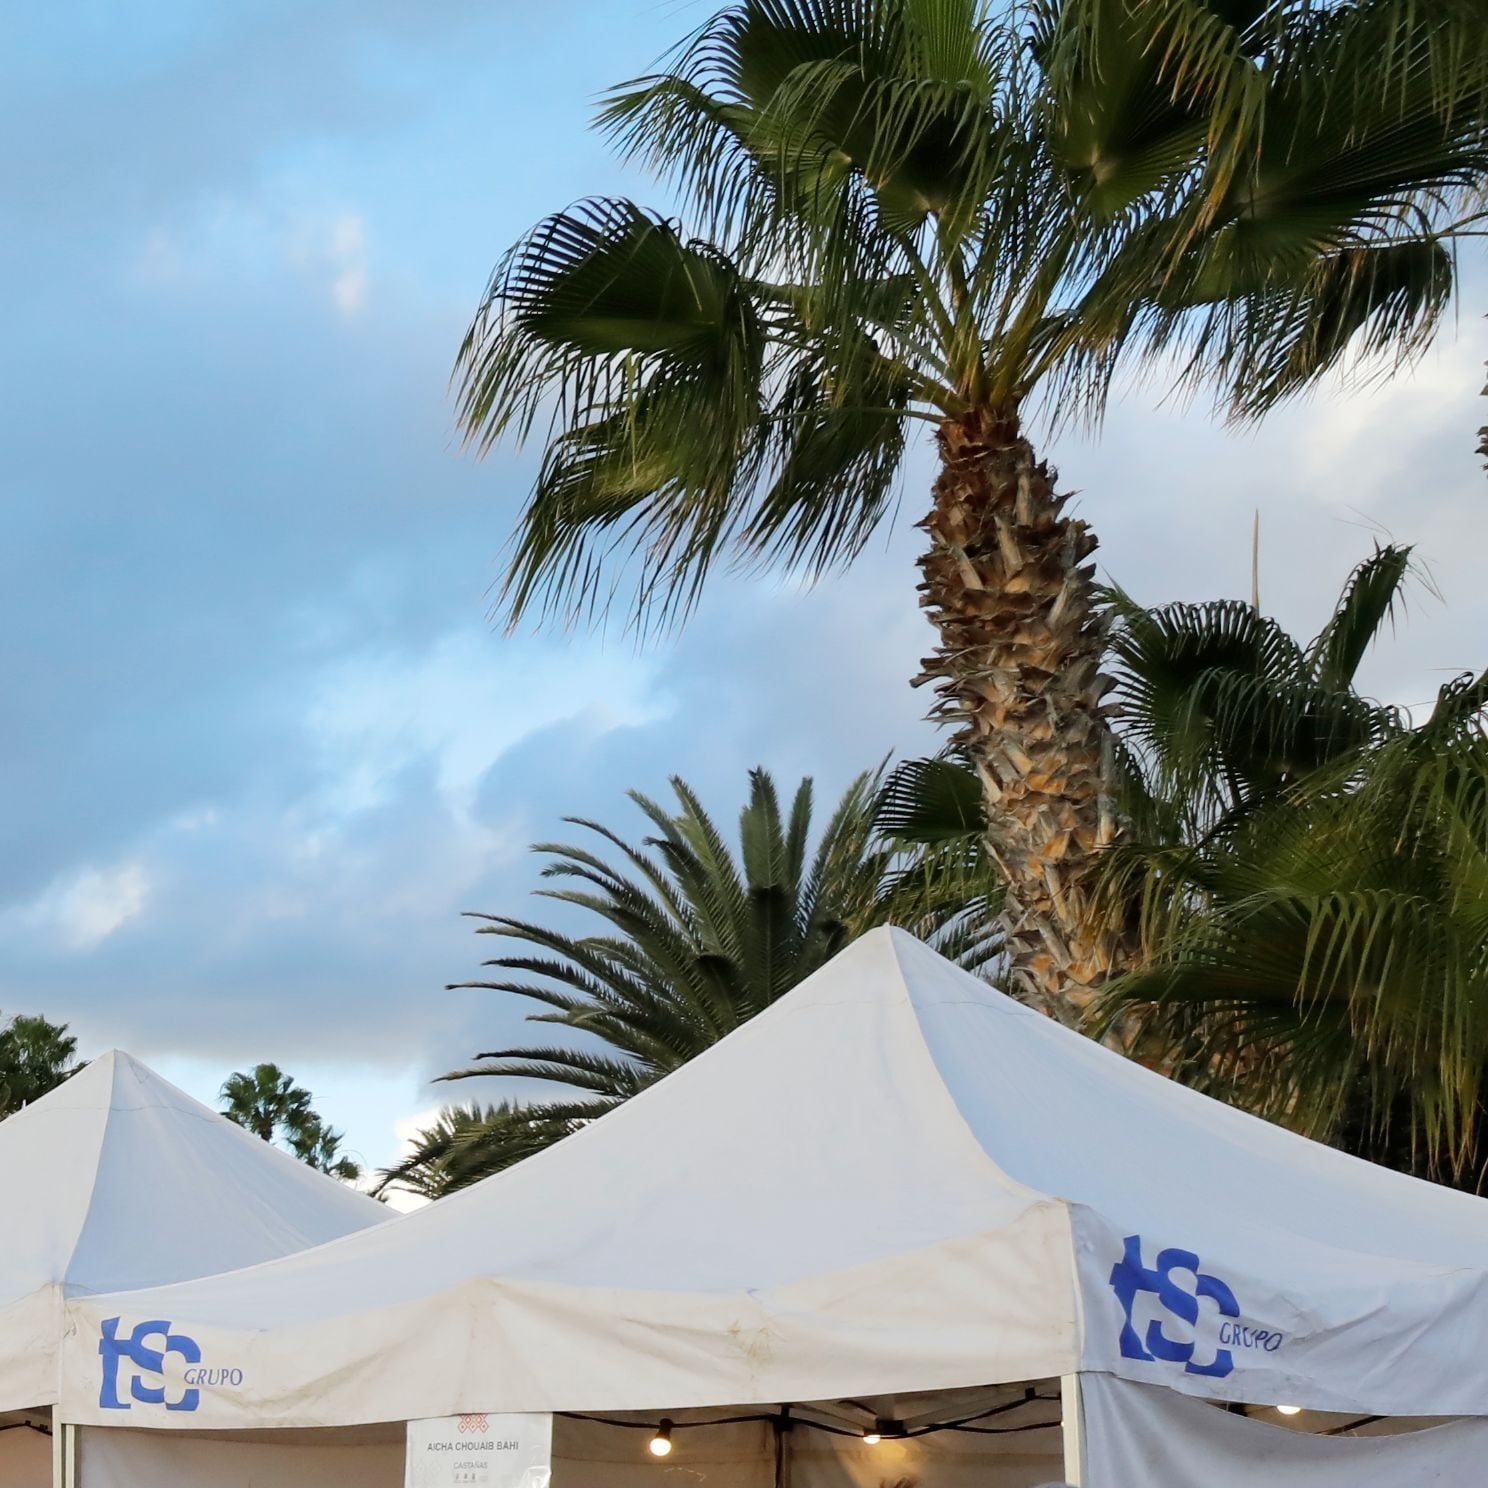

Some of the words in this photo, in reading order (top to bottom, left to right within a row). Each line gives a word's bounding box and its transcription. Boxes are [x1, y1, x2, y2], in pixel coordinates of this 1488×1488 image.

[1219, 1321, 1283, 1352] GRUPO
[183, 1368, 244, 1386] GRUPO
[427, 1442, 453, 1451] AICHA
[455, 1441, 494, 1451] CHOUAIB
